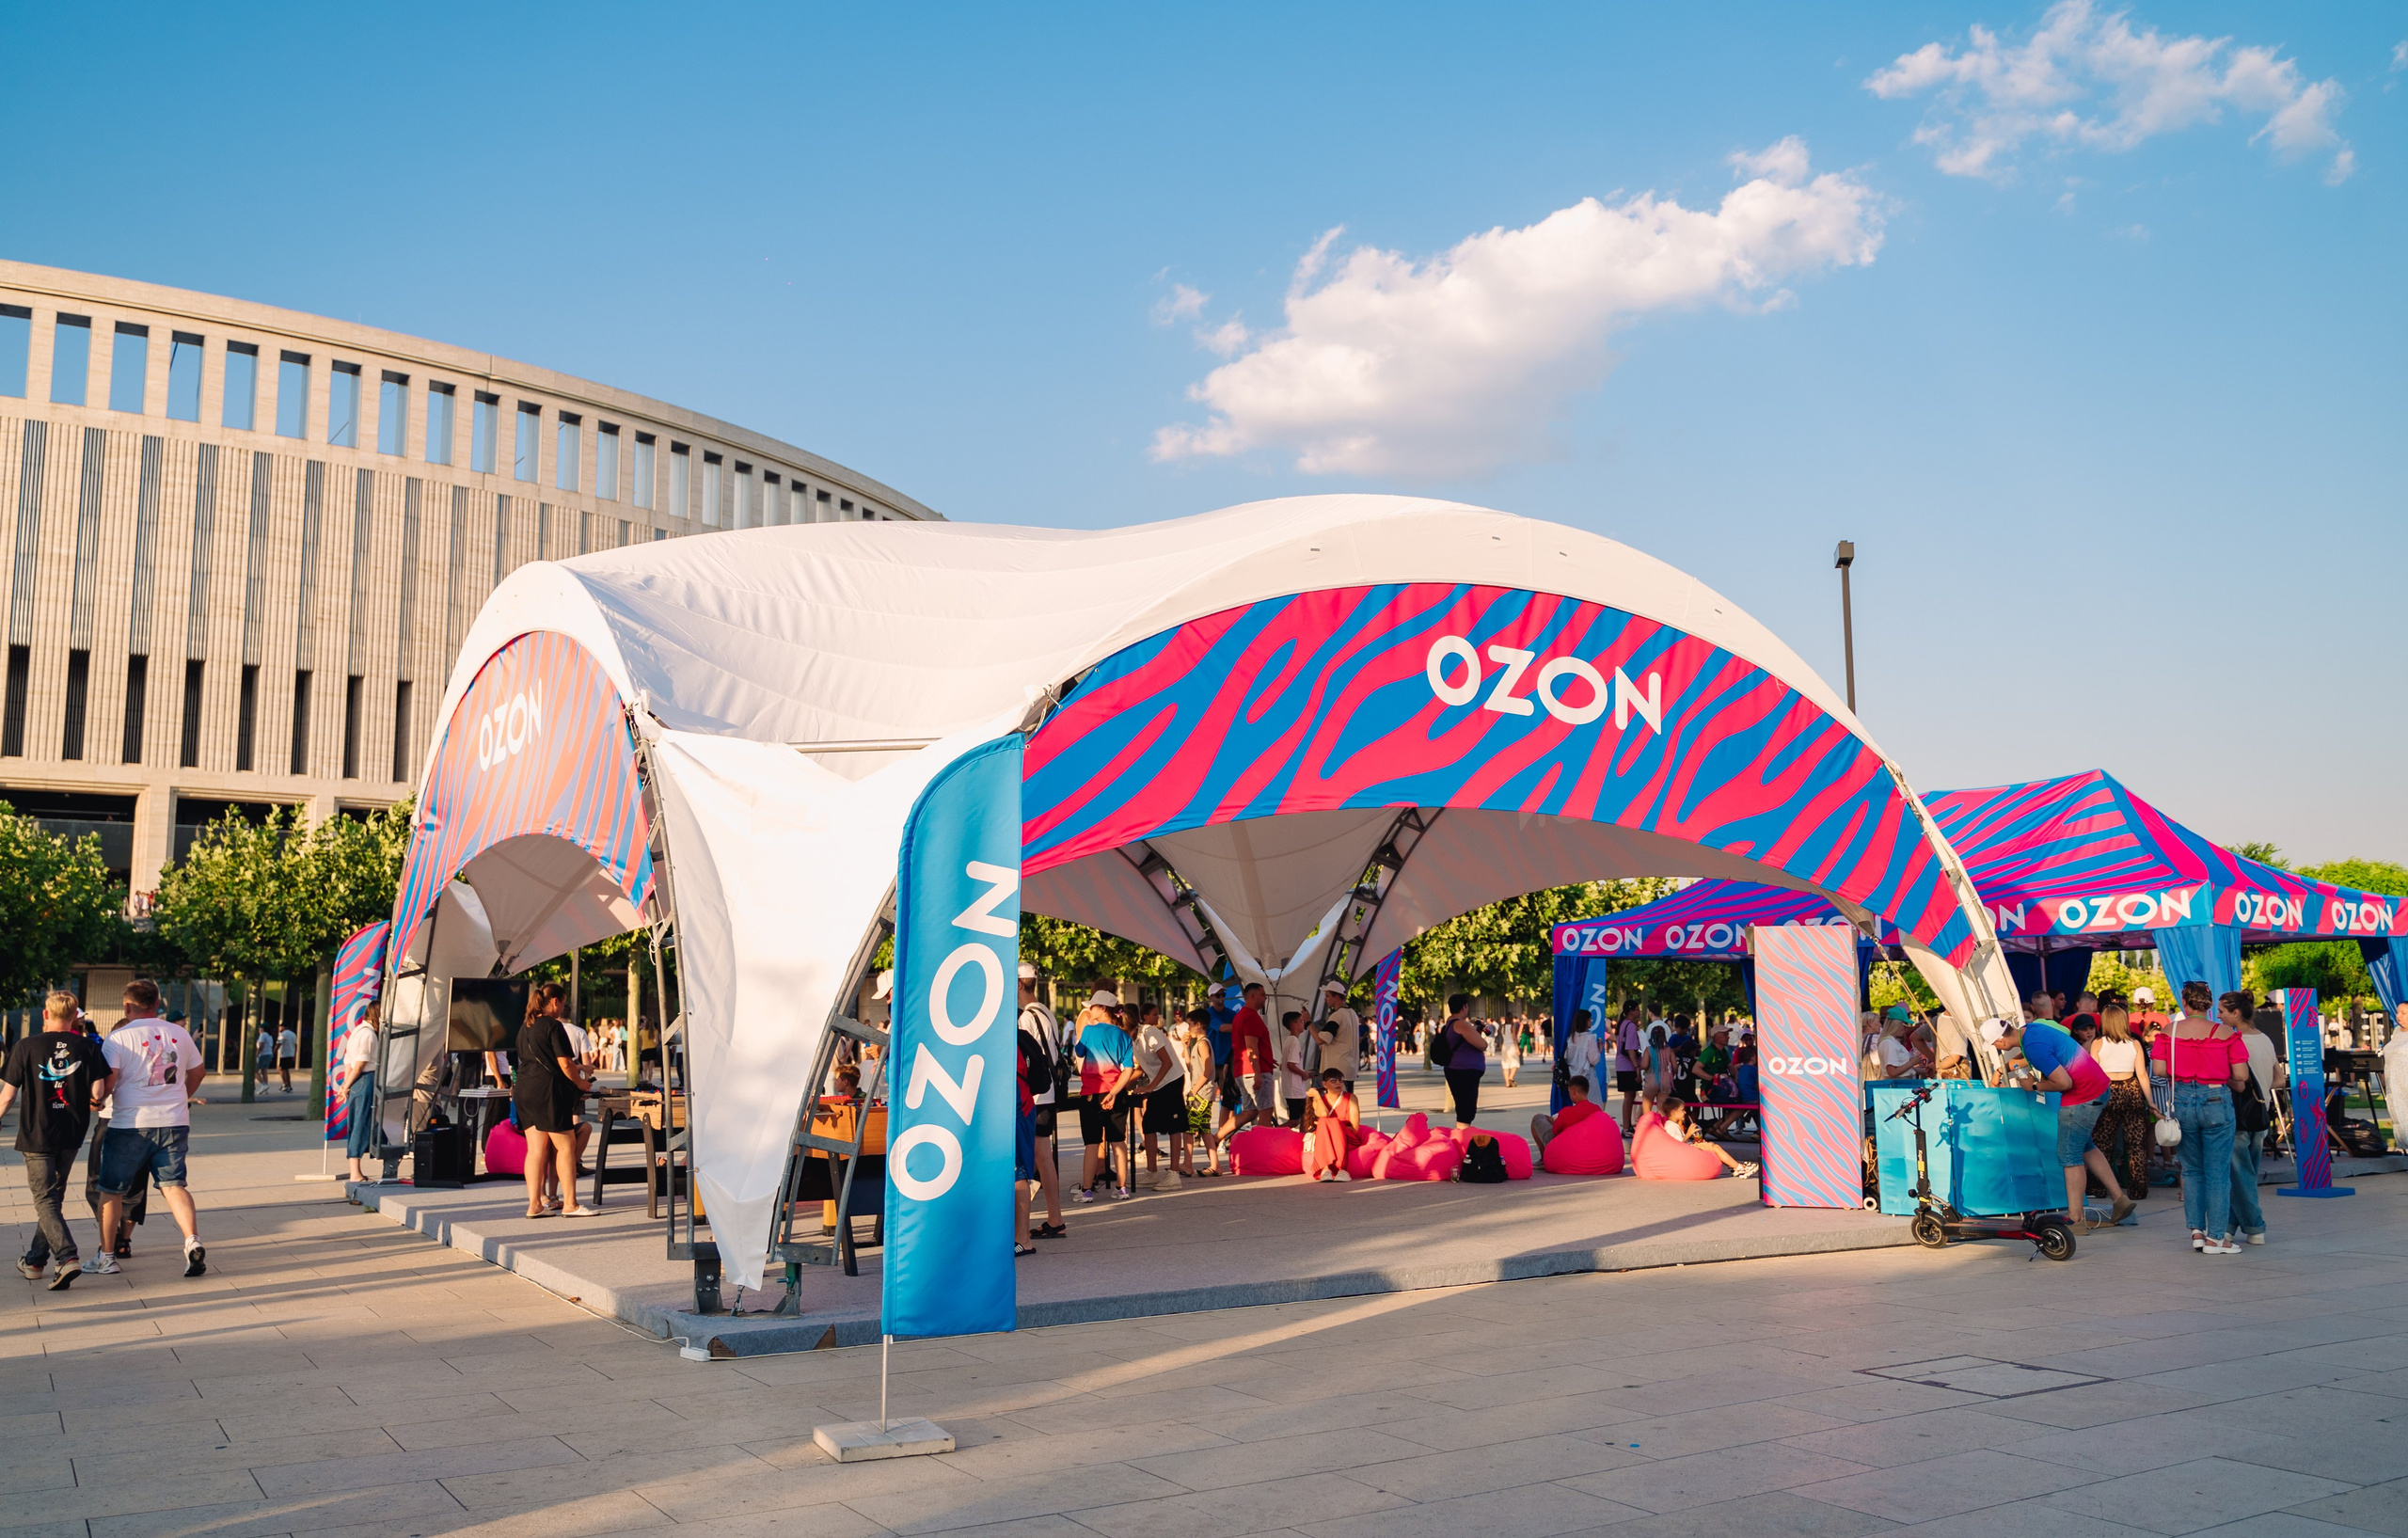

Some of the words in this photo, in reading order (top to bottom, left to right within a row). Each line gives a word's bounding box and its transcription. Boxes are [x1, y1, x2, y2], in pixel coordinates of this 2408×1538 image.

[1426, 634, 1662, 736] OZON
[479, 677, 542, 772] OZON
[1561, 927, 1642, 952] OZON
[2058, 889, 2192, 929] OZON
[2234, 892, 2304, 928] OZON
[2331, 900, 2394, 931] OZON
[889, 860, 1019, 1201] OZON
[1378, 979, 1399, 1072] OZON
[1768, 1056, 1847, 1075] OZON
